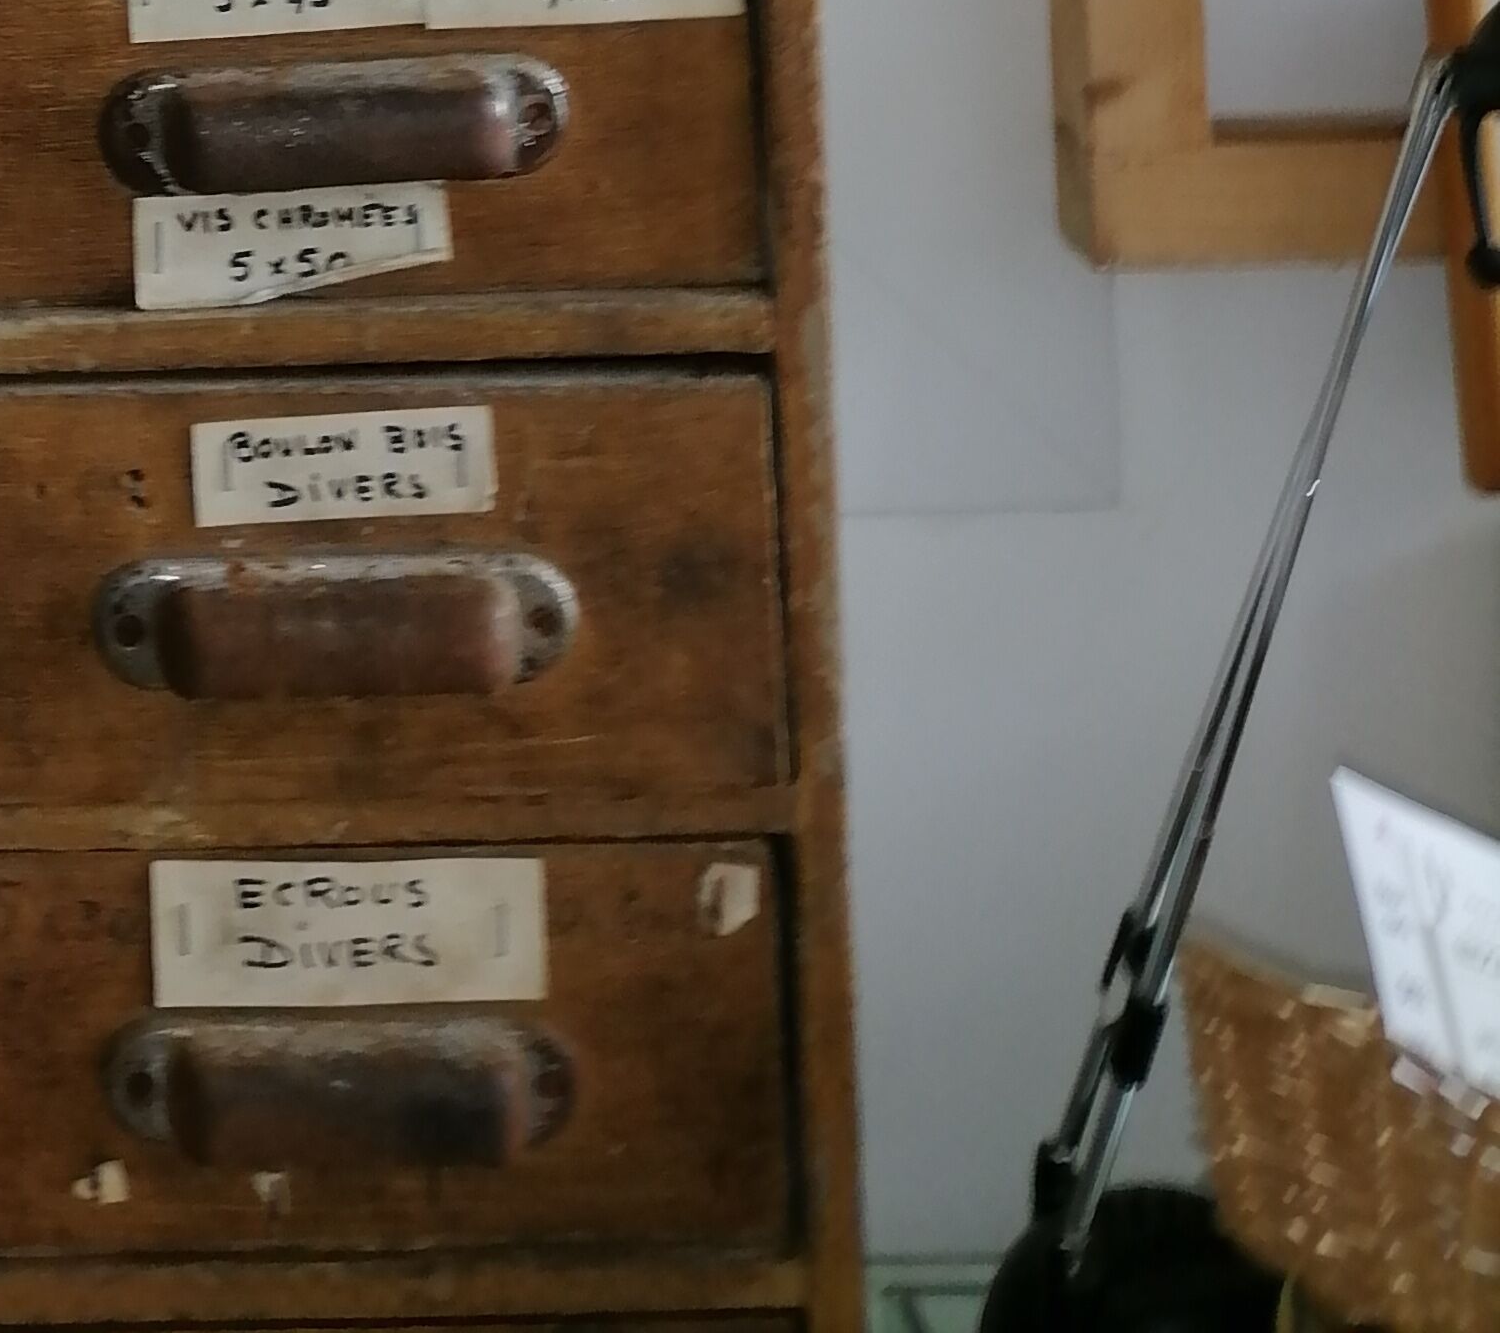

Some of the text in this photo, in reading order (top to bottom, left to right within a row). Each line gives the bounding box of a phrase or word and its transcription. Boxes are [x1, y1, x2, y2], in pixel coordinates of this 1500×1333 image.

[177, 207, 232, 233] VIS
[234, 876, 430, 909] ECROUS
[237, 934, 440, 969] DIVERS
